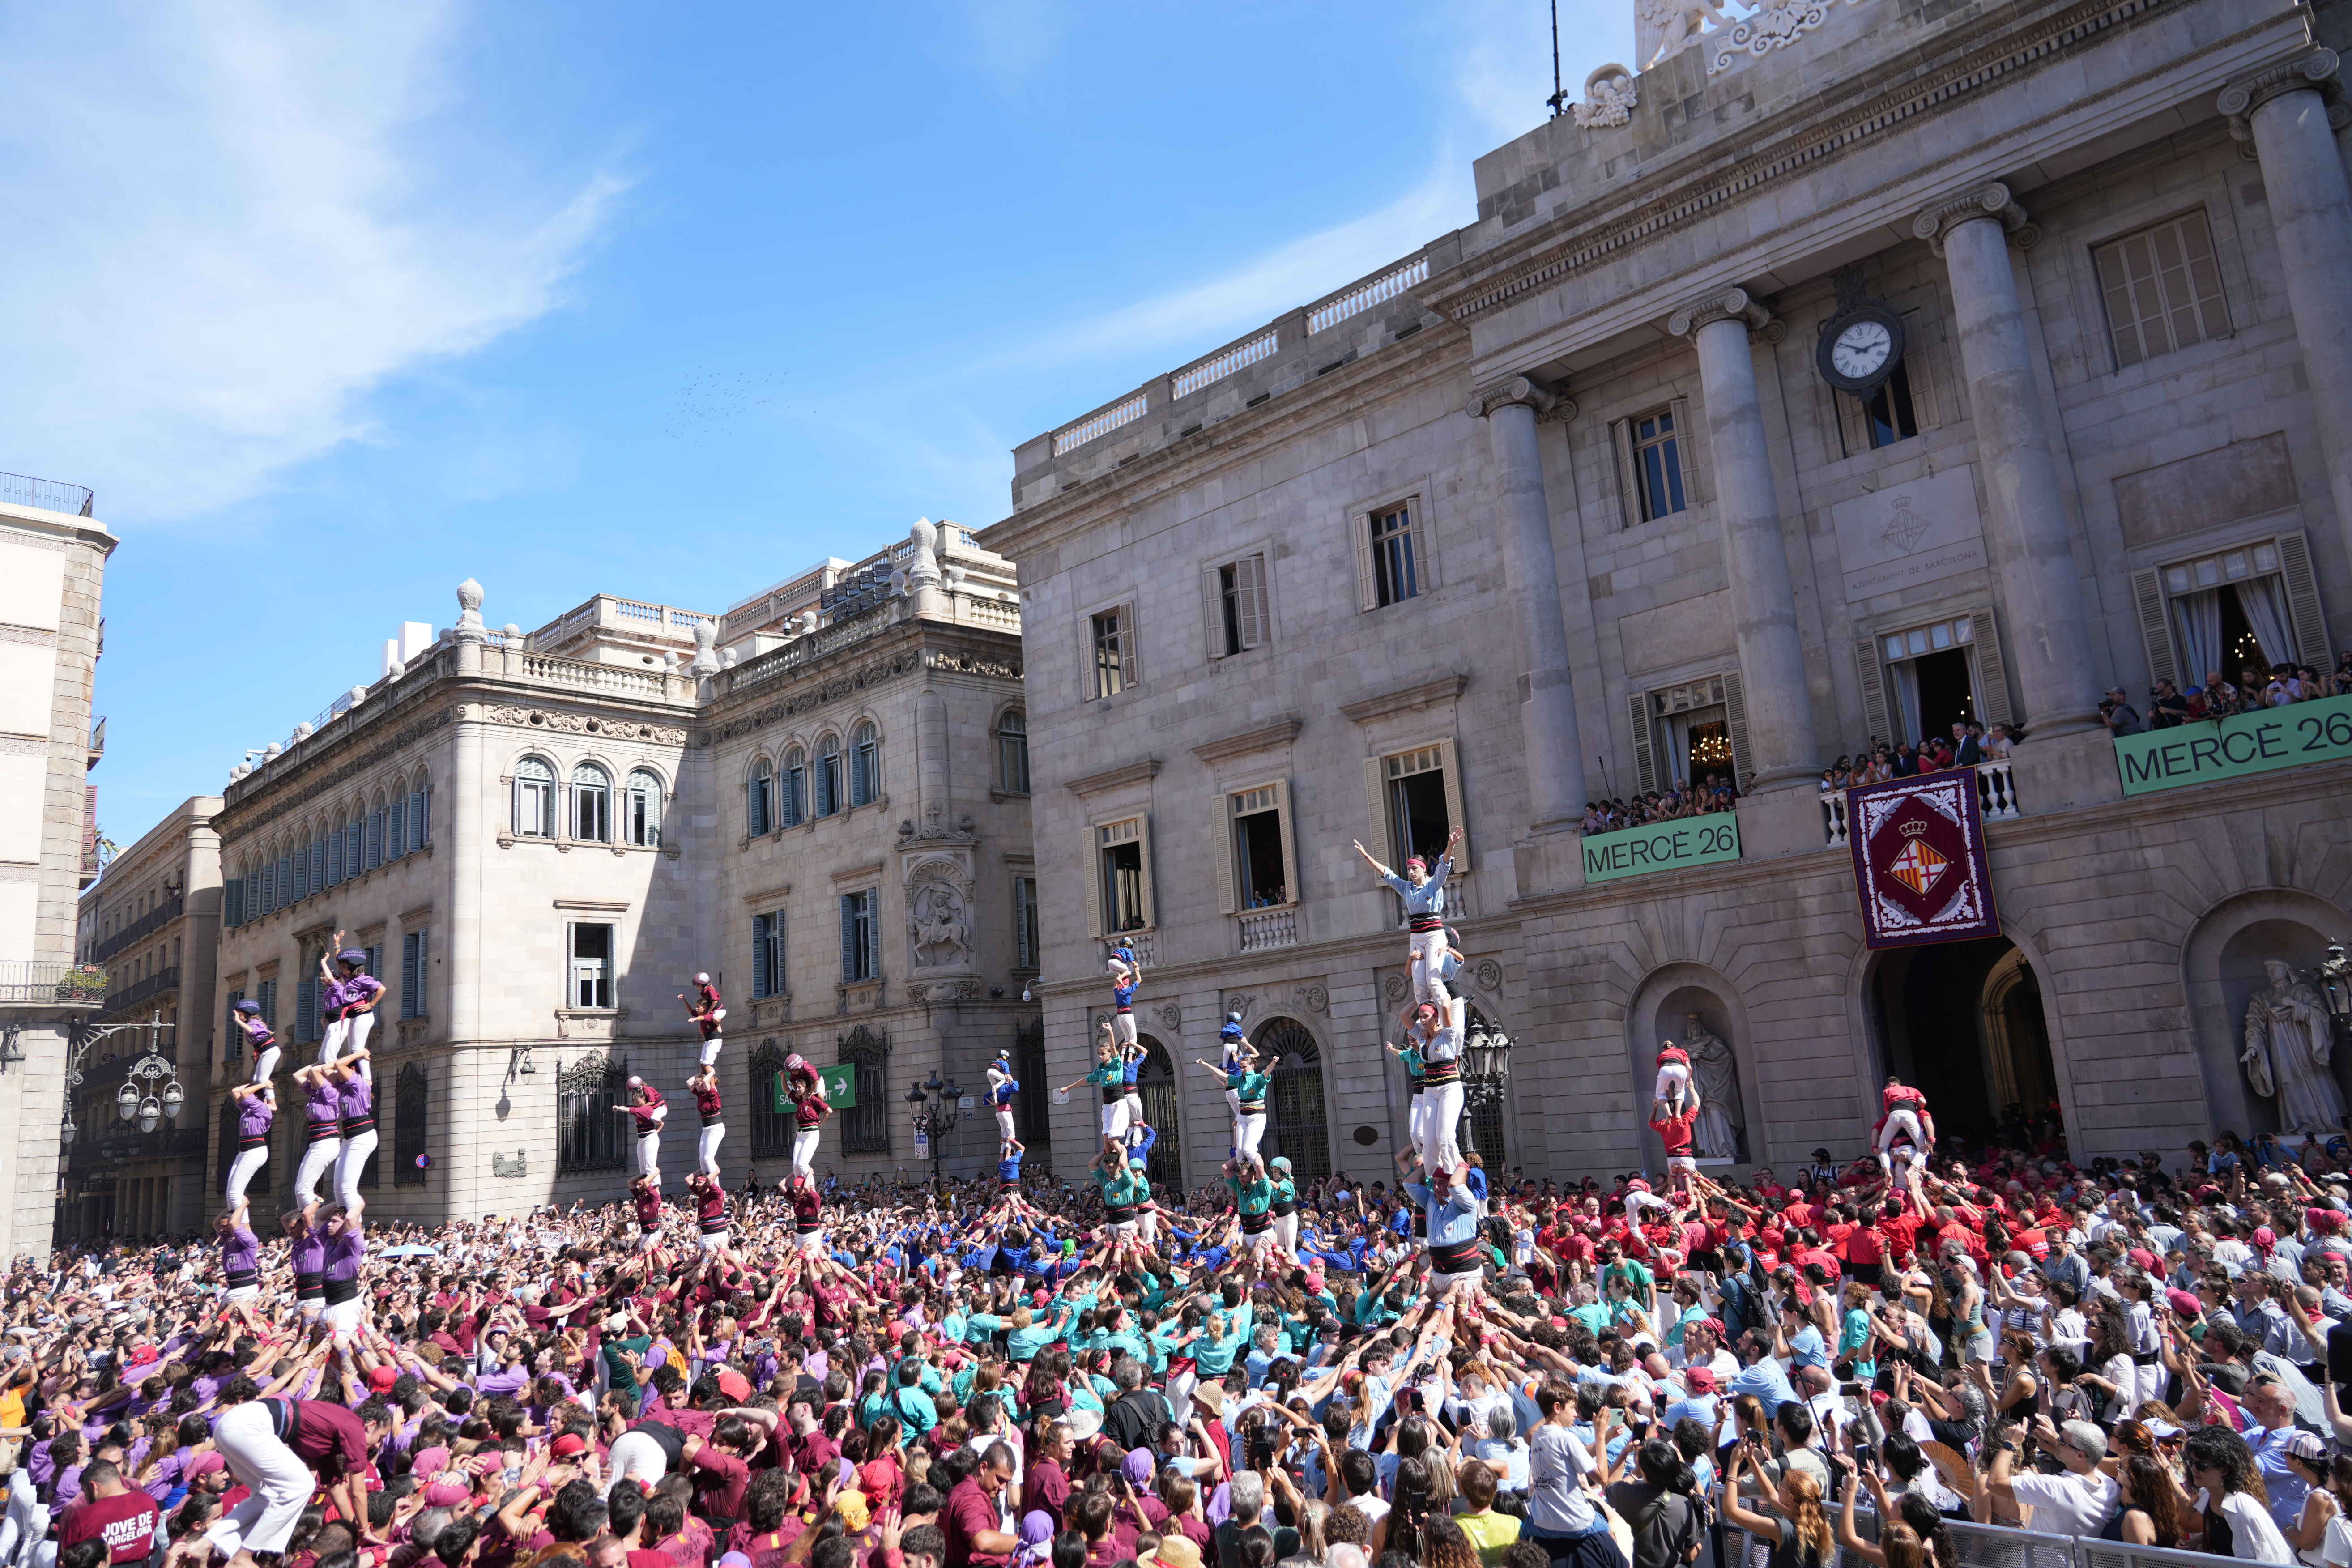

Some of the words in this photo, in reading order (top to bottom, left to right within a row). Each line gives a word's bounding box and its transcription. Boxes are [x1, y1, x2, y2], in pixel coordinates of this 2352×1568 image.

[1852, 569, 1905, 590] AJUNTAMENT
[1909, 566, 1921, 575] DE
[1925, 550, 1978, 570] BARCELONA
[2124, 722, 2289, 784] MERCÈ
[2297, 712, 2352, 752] 26
[1587, 830, 1692, 874] MERCÈ
[1698, 824, 1734, 855] 26
[101, 1517, 136, 1538] JOVE
[138, 1510, 153, 1527] DE
